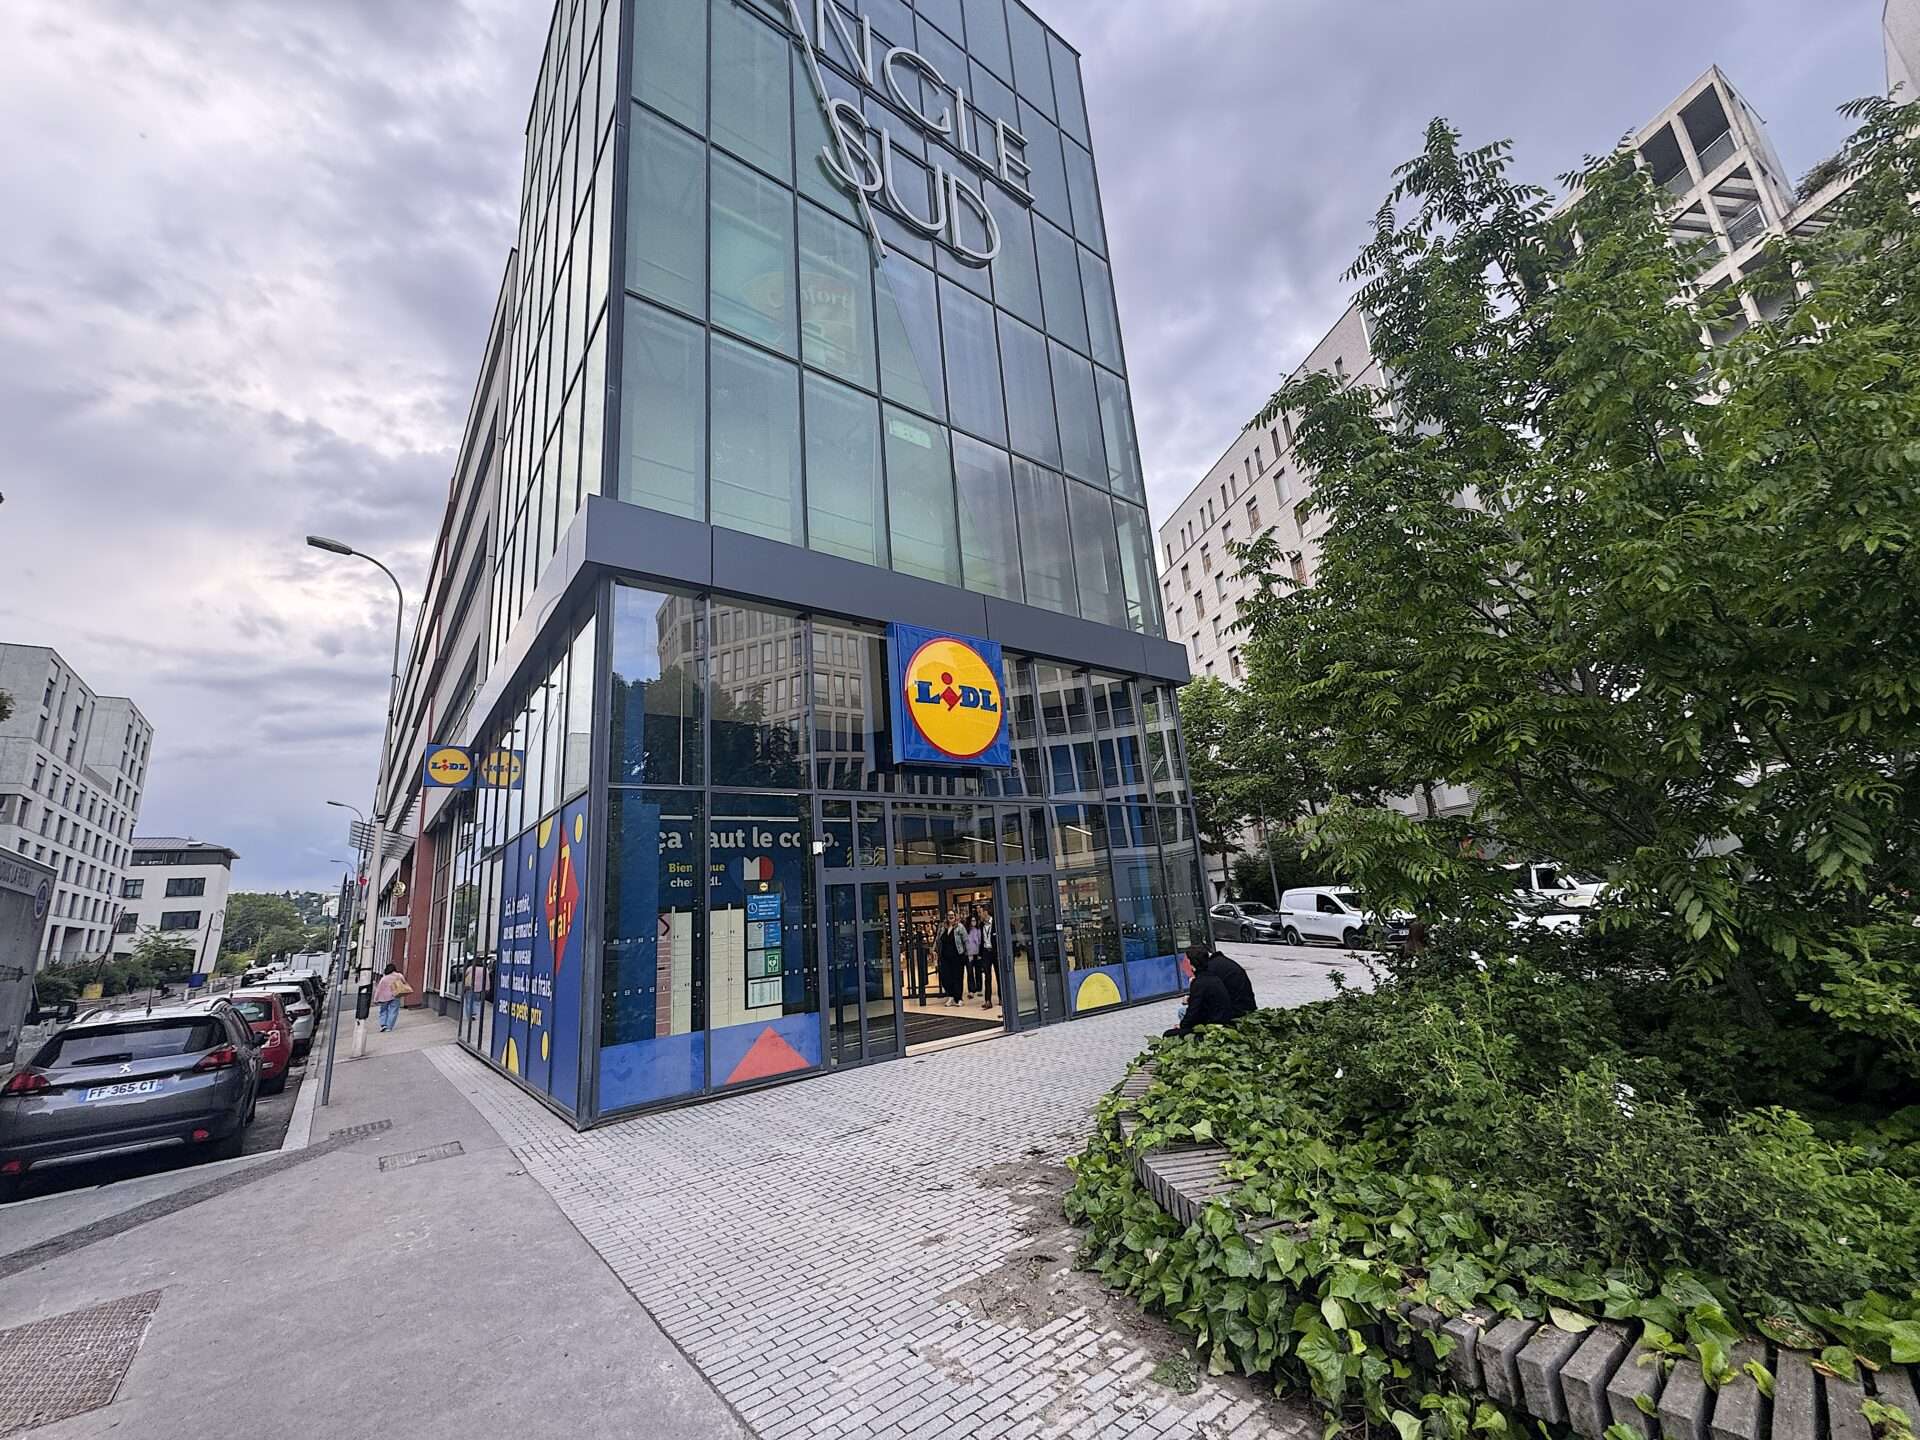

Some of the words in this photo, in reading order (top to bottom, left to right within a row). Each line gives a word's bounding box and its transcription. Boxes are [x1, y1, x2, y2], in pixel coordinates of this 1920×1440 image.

[822, 98, 1001, 262] SUD
[690, 830, 746, 848] aut
[752, 826, 778, 848] le
[560, 844, 570, 897] 7
[668, 863, 726, 873] Bienue
